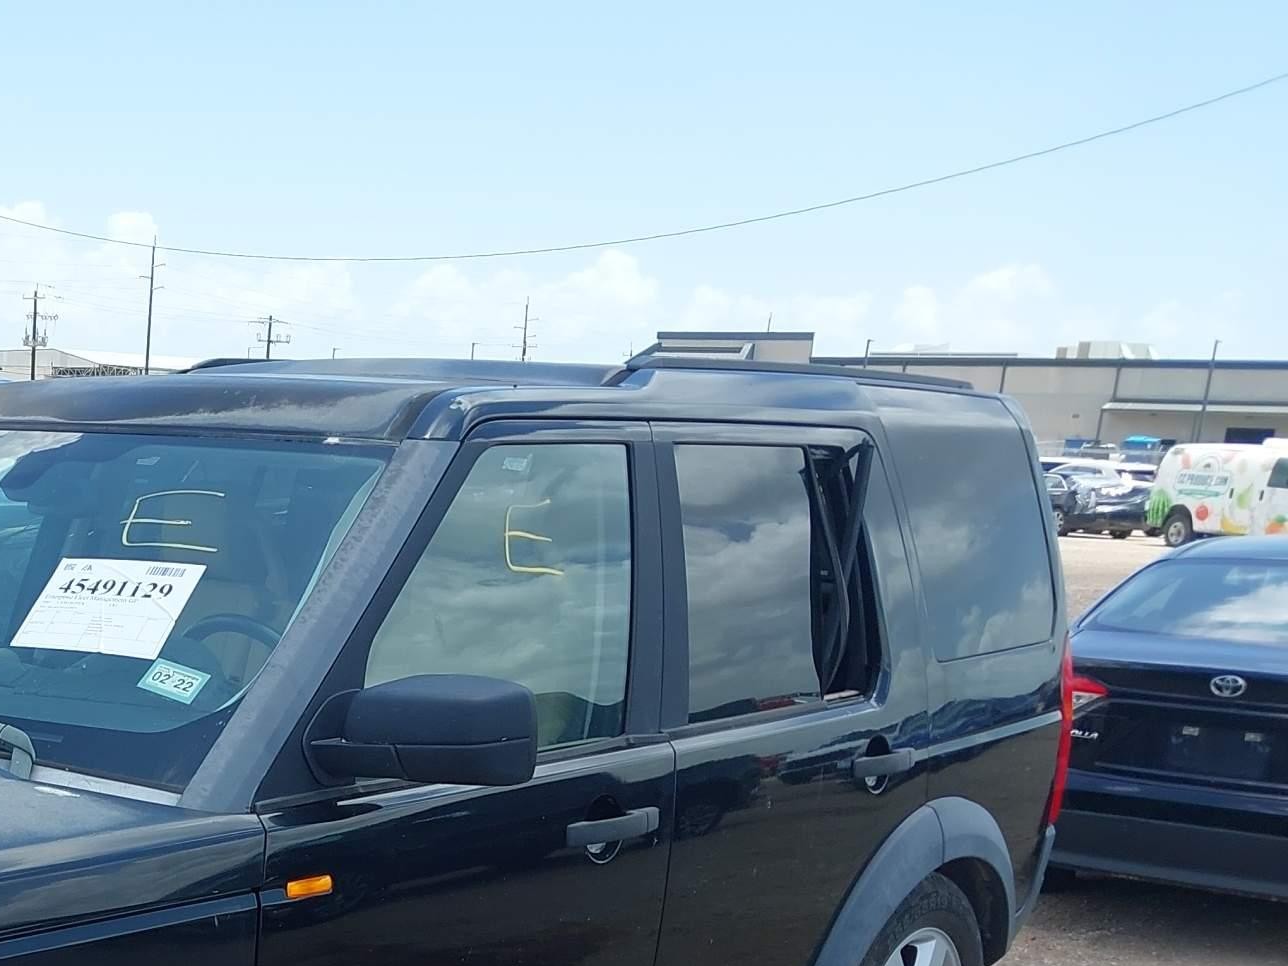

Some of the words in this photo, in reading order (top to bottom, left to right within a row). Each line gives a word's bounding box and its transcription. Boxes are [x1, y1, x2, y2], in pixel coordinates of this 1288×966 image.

[119, 489, 225, 552] E
[503, 498, 565, 575] E
[58, 577, 173, 600] 45491129
[152, 671, 172, 685] 02
[173, 678, 194, 692] 22
